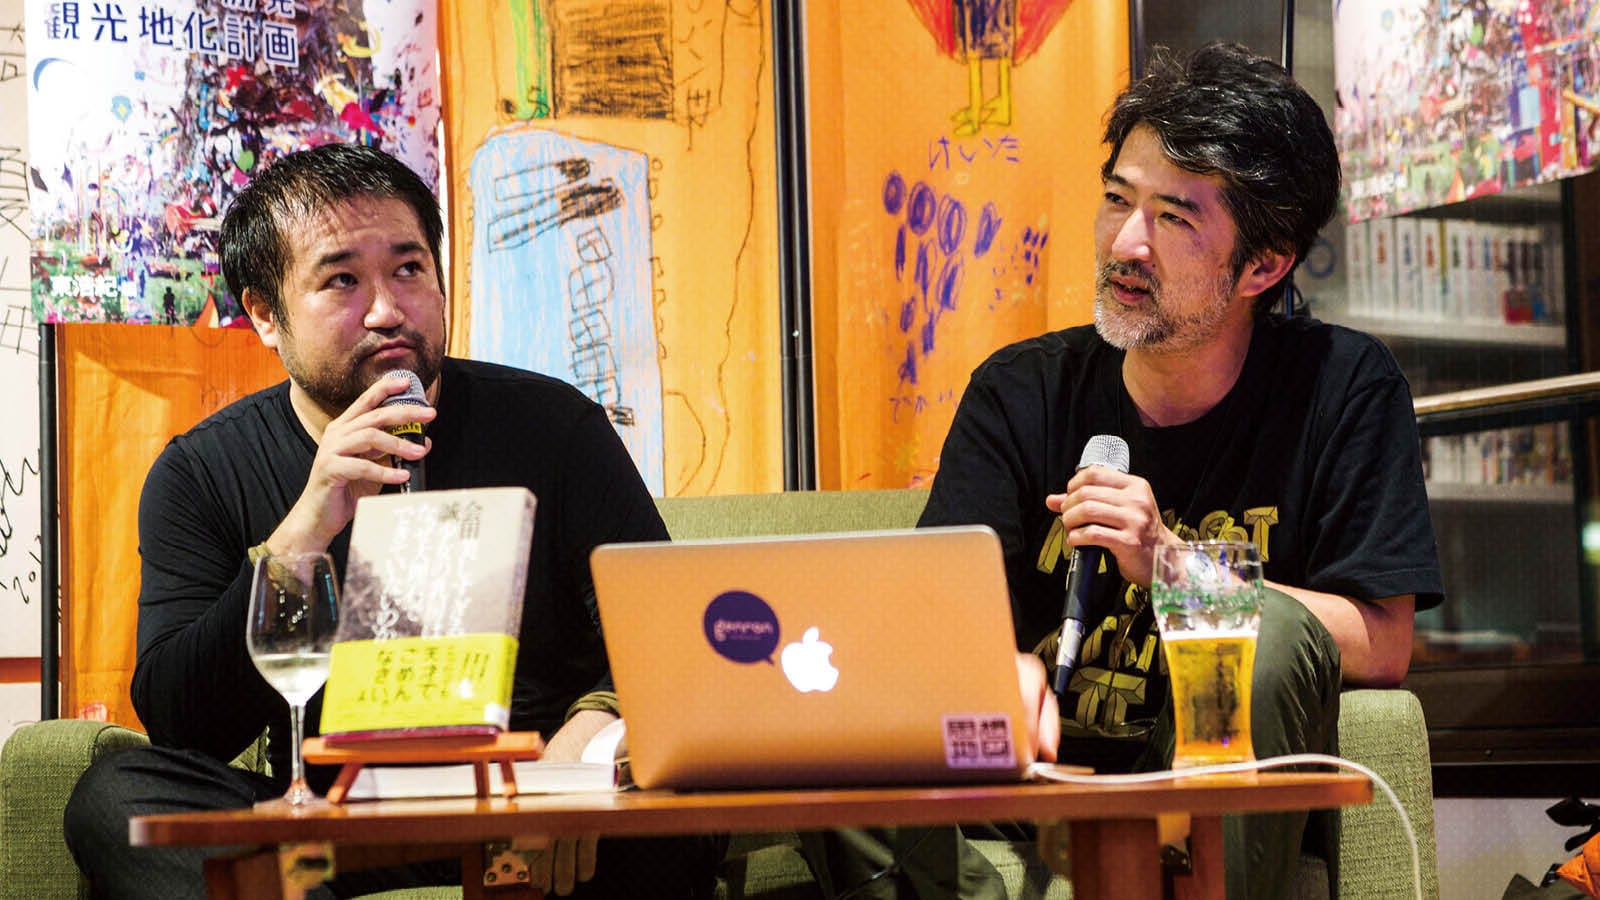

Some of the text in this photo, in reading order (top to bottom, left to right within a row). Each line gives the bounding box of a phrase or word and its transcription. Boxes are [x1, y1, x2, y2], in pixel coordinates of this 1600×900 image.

[46, 2, 297, 65] 観光地化計画
